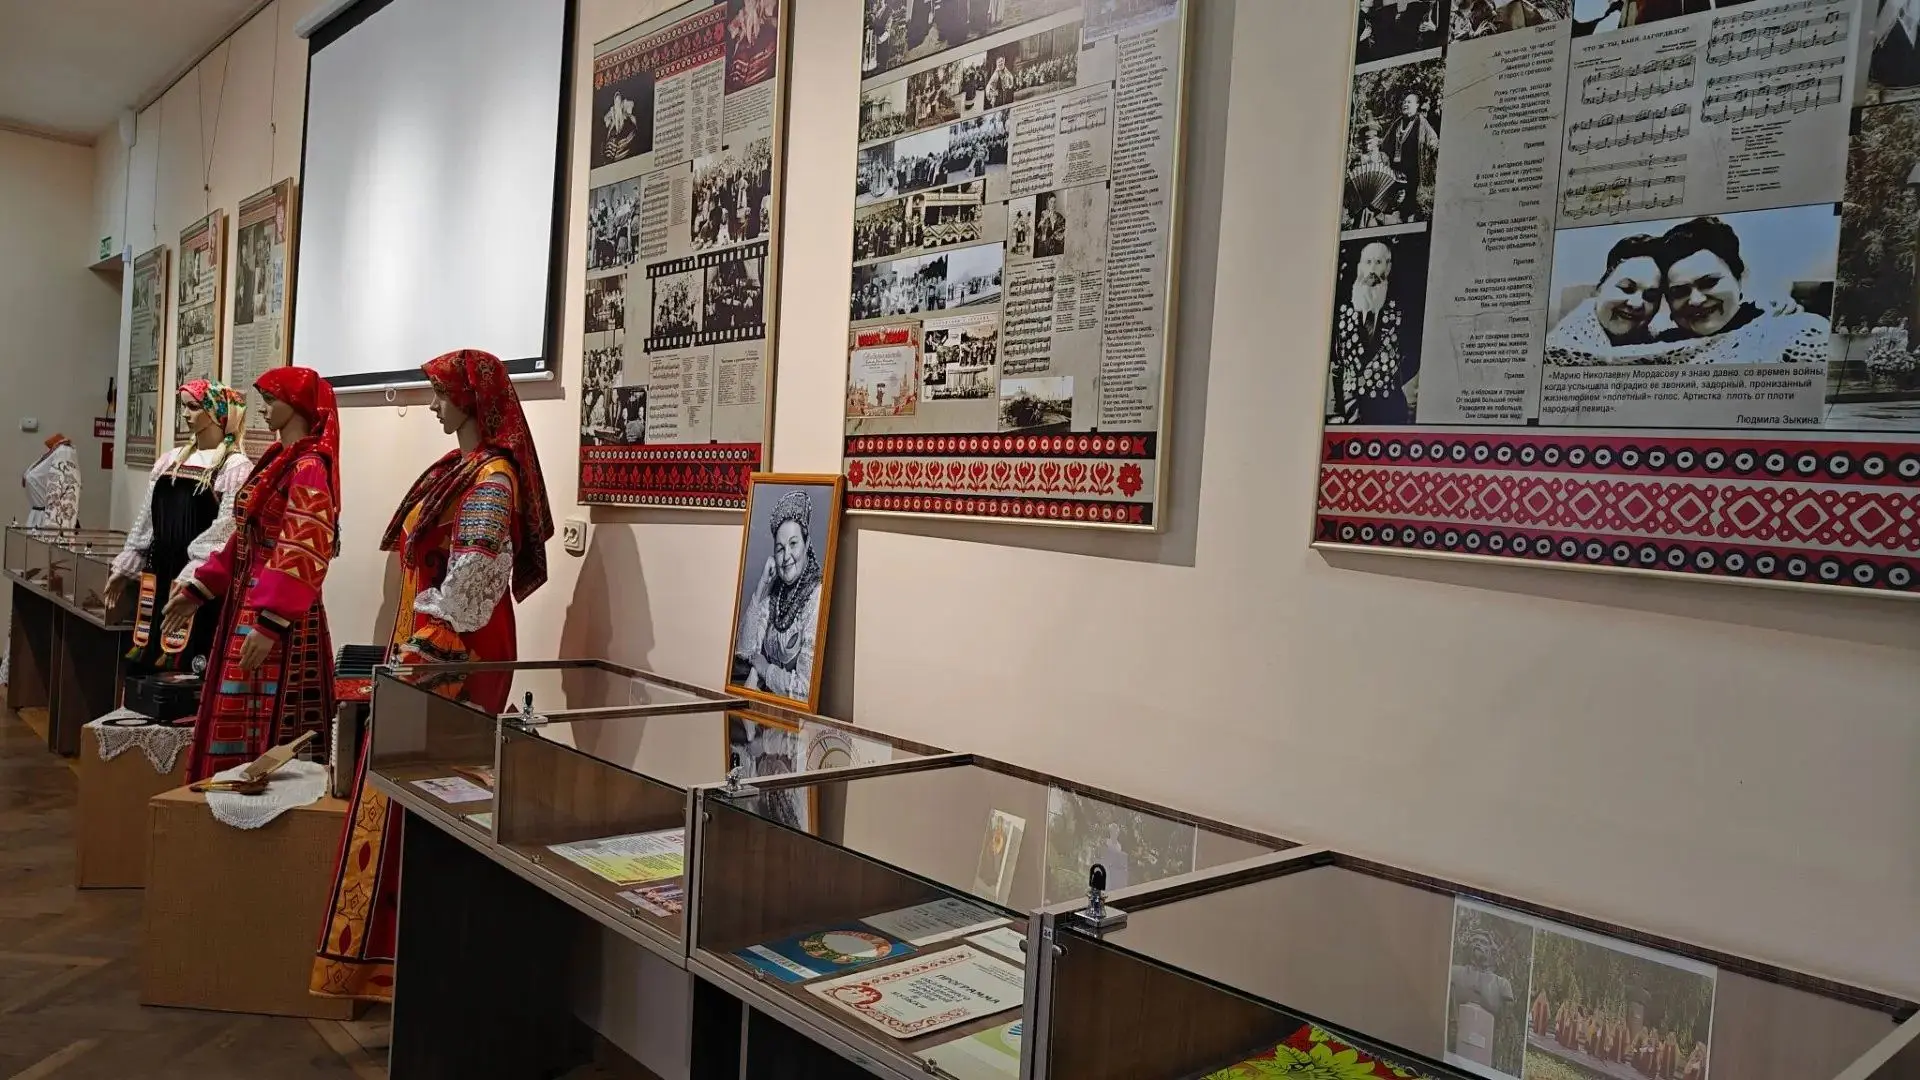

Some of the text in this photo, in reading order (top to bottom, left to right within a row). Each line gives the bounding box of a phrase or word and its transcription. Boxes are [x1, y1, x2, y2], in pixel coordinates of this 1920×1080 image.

[1583, 371, 1631, 380] Николаевну
[1633, 369, 1679, 379] Мордасову
[1688, 369, 1710, 378] знаю
[1757, 368, 1790, 378] времен
[1793, 366, 1825, 377] войны,
[1545, 383, 1566, 391] когда
[1568, 383, 1609, 392] услышала
[1624, 382, 1648, 391] радио
[1750, 379, 1812, 389] пронизанный
[1544, 394, 1600, 402] жизнелюбием
[1683, 391, 1721, 402] Артистка
[1543, 405, 1580, 414] народная
[1736, 414, 1780, 425] Людмила
[936, 974, 1000, 1004] ПРОГРАММА
